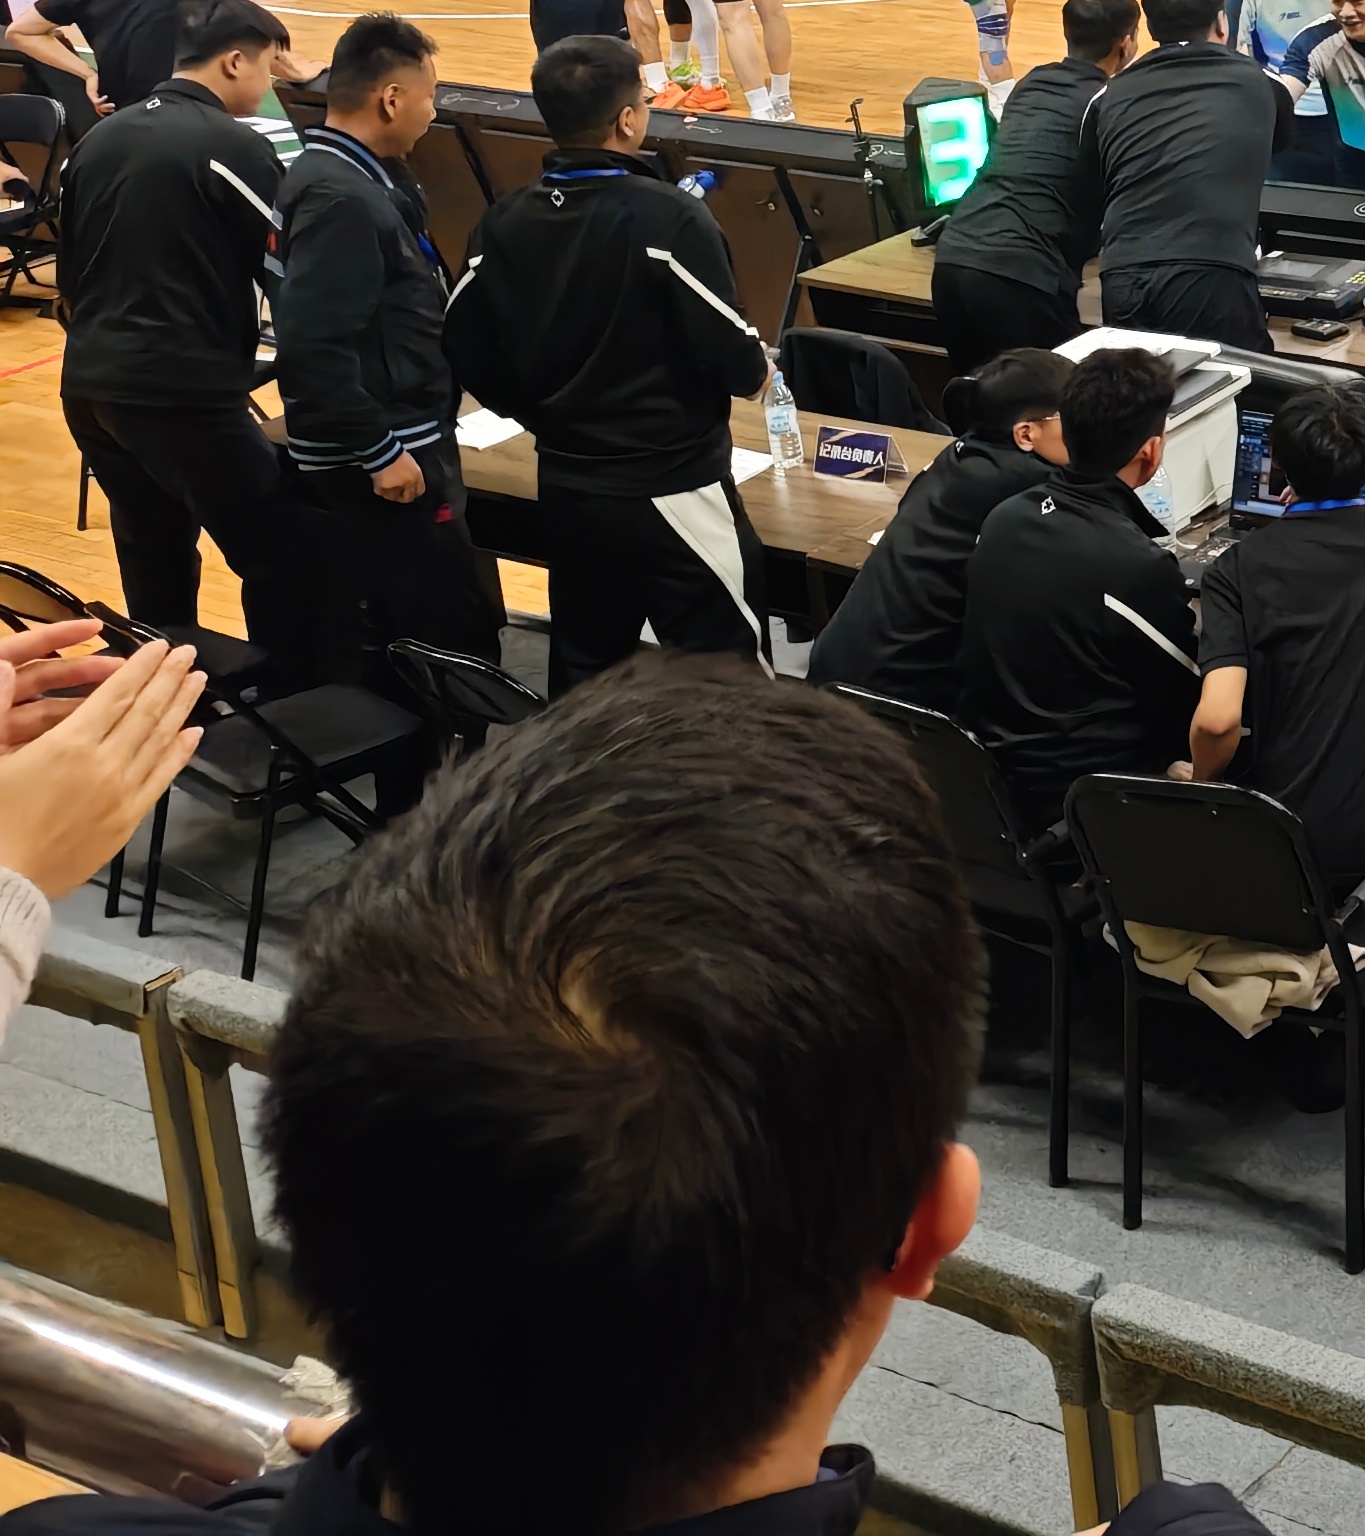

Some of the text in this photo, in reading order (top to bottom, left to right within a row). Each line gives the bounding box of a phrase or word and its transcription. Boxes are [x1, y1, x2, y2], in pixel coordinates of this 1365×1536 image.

[819, 443, 885, 467] 记录台负责人
